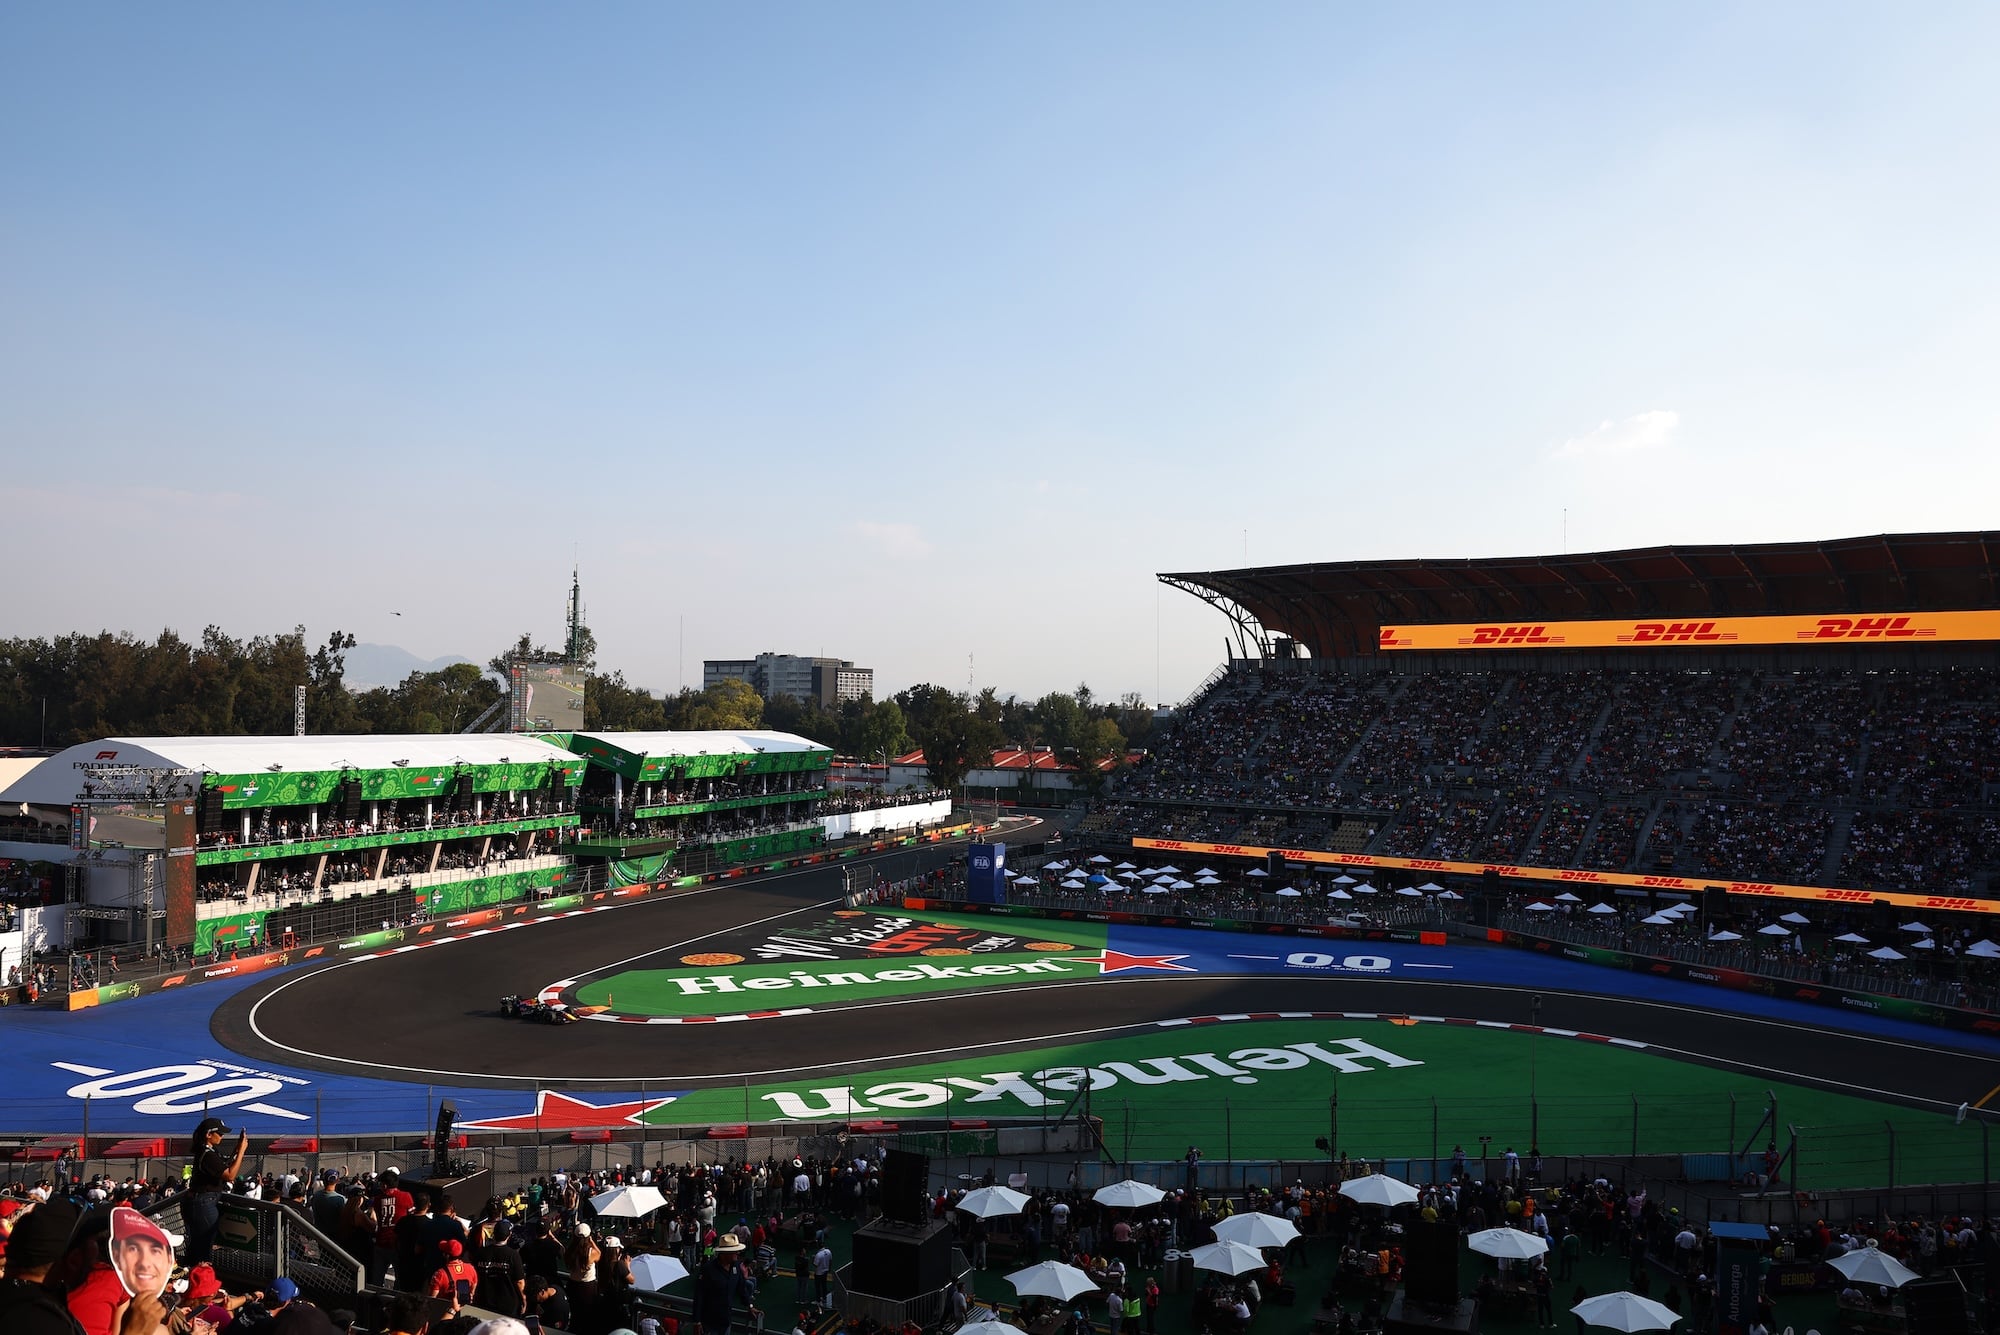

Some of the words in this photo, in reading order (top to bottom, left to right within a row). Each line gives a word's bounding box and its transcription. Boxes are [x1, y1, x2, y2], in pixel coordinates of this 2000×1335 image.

[1632, 622, 1721, 642] DHL
[1814, 617, 1916, 638] DHL
[1471, 626, 1552, 644] DHL
[72, 762, 139, 770] PADDOCK
[1155, 840, 1183, 849] DHL
[1213, 845, 1242, 854] DHL
[974, 857, 990, 868] FIA
[1340, 855, 1374, 864] DHL
[1409, 860, 1444, 870] DHL
[1560, 871, 1600, 882] DHL
[1643, 876, 1685, 888] DHL
[1730, 883, 1777, 895] DHL
[1824, 889, 1873, 902] DHL
[1926, 897, 1979, 910] DHL
[338, 939, 361, 950] Formula
[1286, 952, 1392, 970] 0.0
[204, 967, 232, 978] Formula
[667, 958, 1072, 995] Heineken
[1688, 969, 1713, 981] Formula
[1841, 996, 1873, 1008] Formula
[760, 1037, 1425, 1118] Heineken
[66, 1064, 283, 1115] 0.0
[1780, 1272, 1817, 1287] BEBIDAS
[1728, 1264, 1742, 1323] Autocarga
